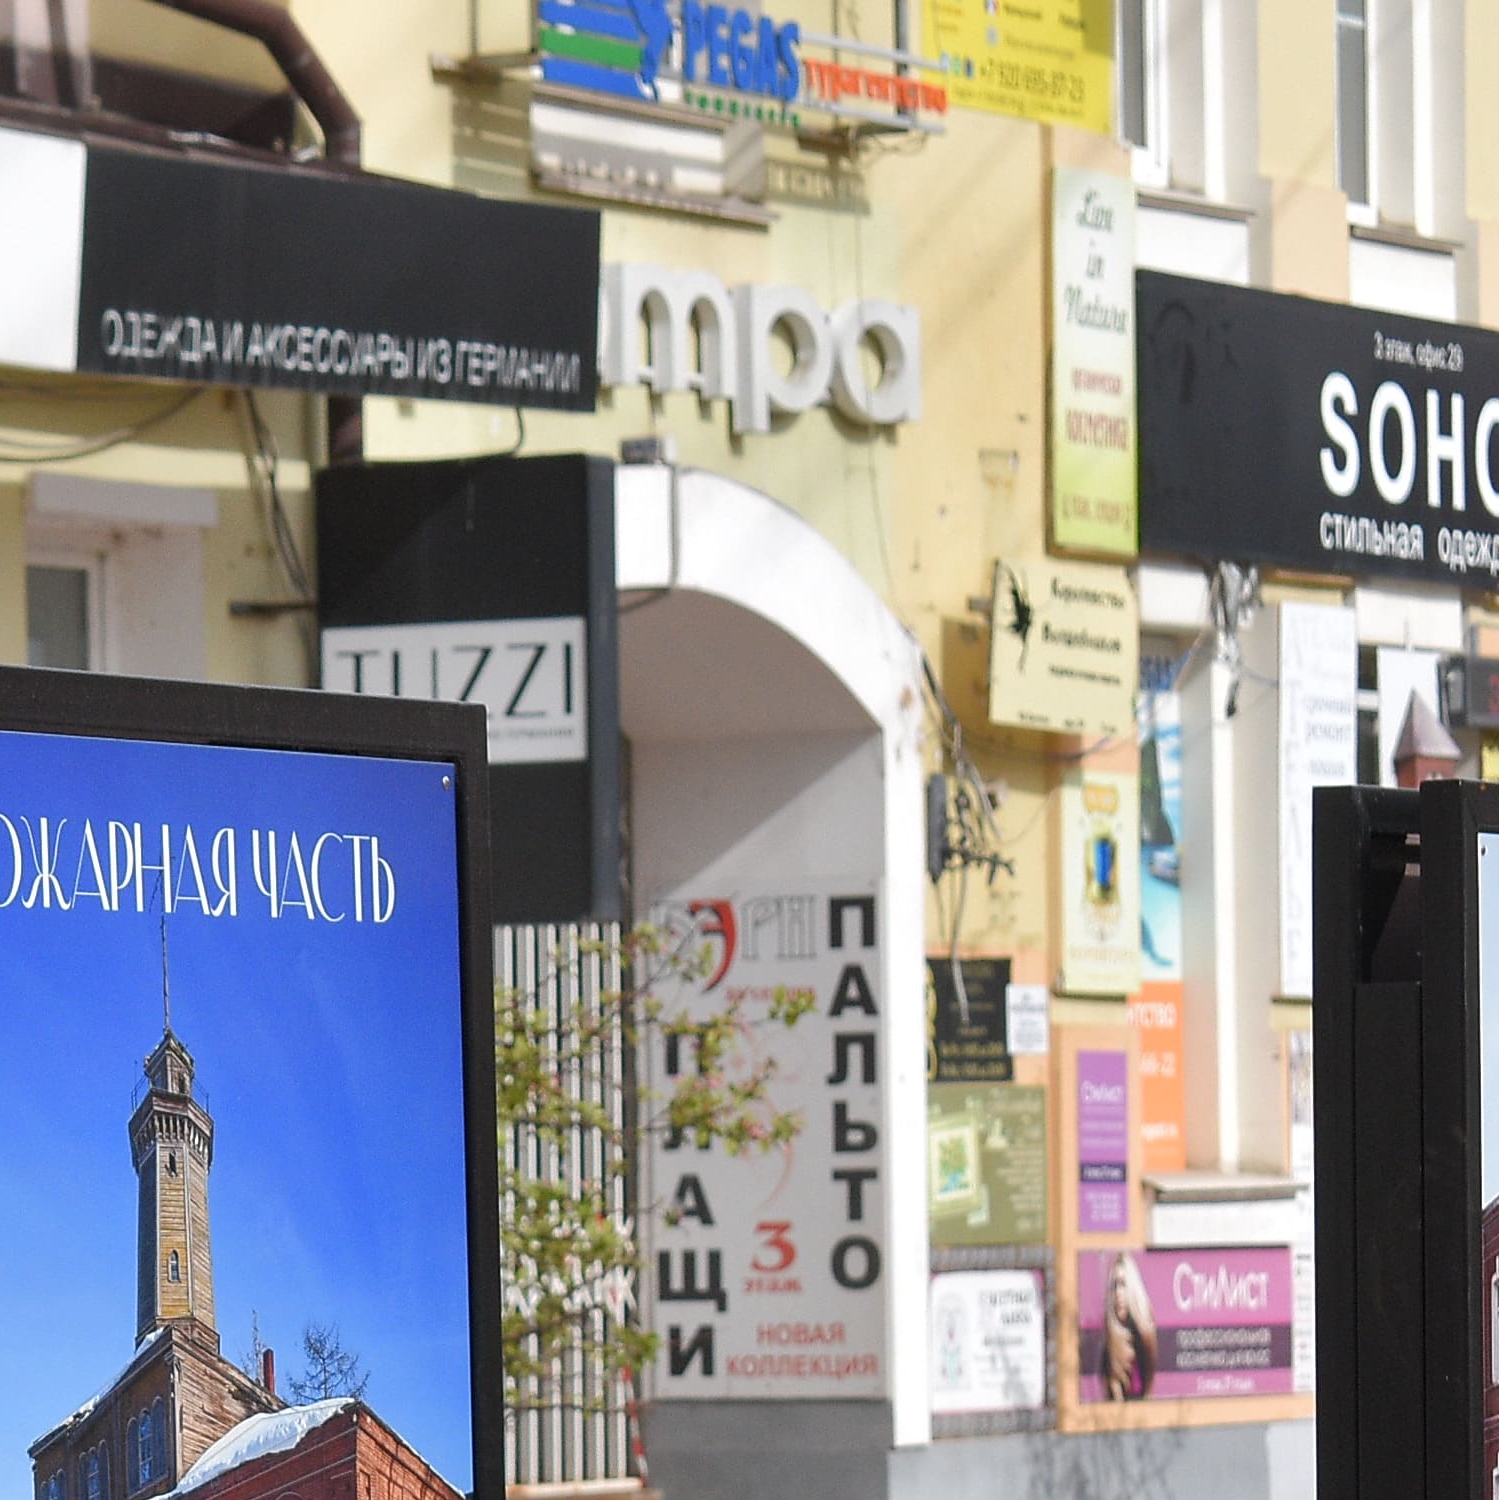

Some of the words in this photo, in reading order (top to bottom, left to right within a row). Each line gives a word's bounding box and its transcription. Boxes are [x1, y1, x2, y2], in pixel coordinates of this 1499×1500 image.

[684, 0, 800, 101] PEGAS
[102, 308, 219, 363] ОДЕЖДА
[222, 320, 244, 364] И
[246, 322, 415, 381] АКСЕССУАРЫ
[417, 338, 453, 385] ИЗ
[455, 340, 581, 393] ГЕРМАНИИ
[335, 640, 575, 718] TUZZI
[252, 828, 397, 924] ЧАСТЬ
[826, 894, 881, 1291] ПАЛЬТО
[751, 1220, 799, 1273] 3
[727, 1352, 879, 1379] КОЛЛЕКЦИЯ
[757, 1321, 846, 1346] НОВАЯ
